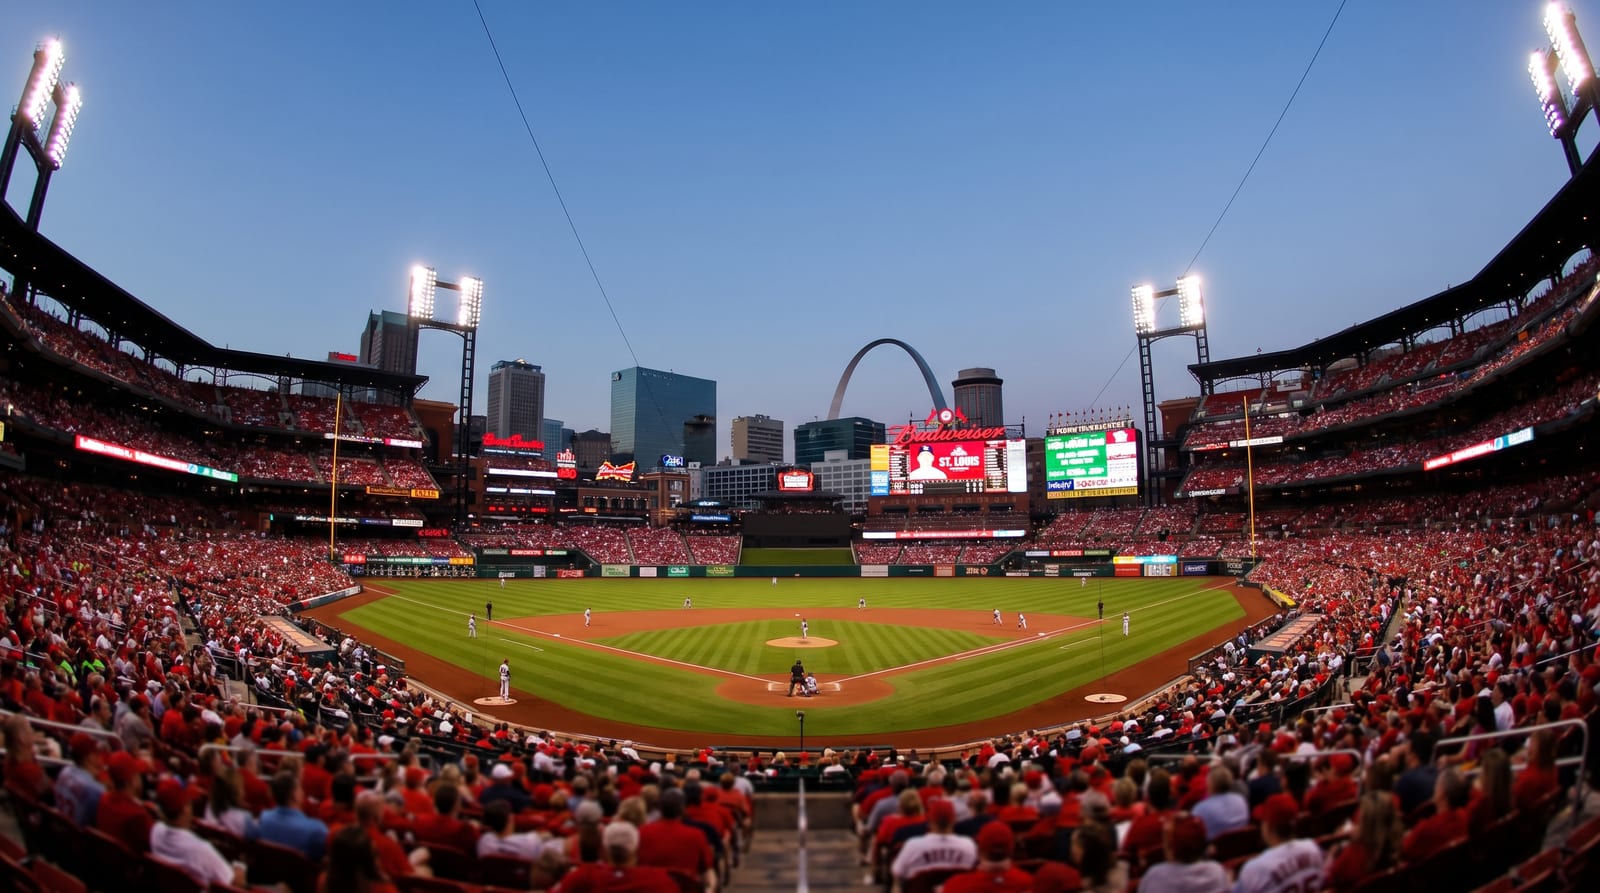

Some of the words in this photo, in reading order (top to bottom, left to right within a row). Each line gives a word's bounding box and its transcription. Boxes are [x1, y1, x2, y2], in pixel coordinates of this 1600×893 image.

[888, 423, 1006, 445] Budweiser
[939, 457, 952, 467] ST.
[953, 456, 980, 466] LOUIS
